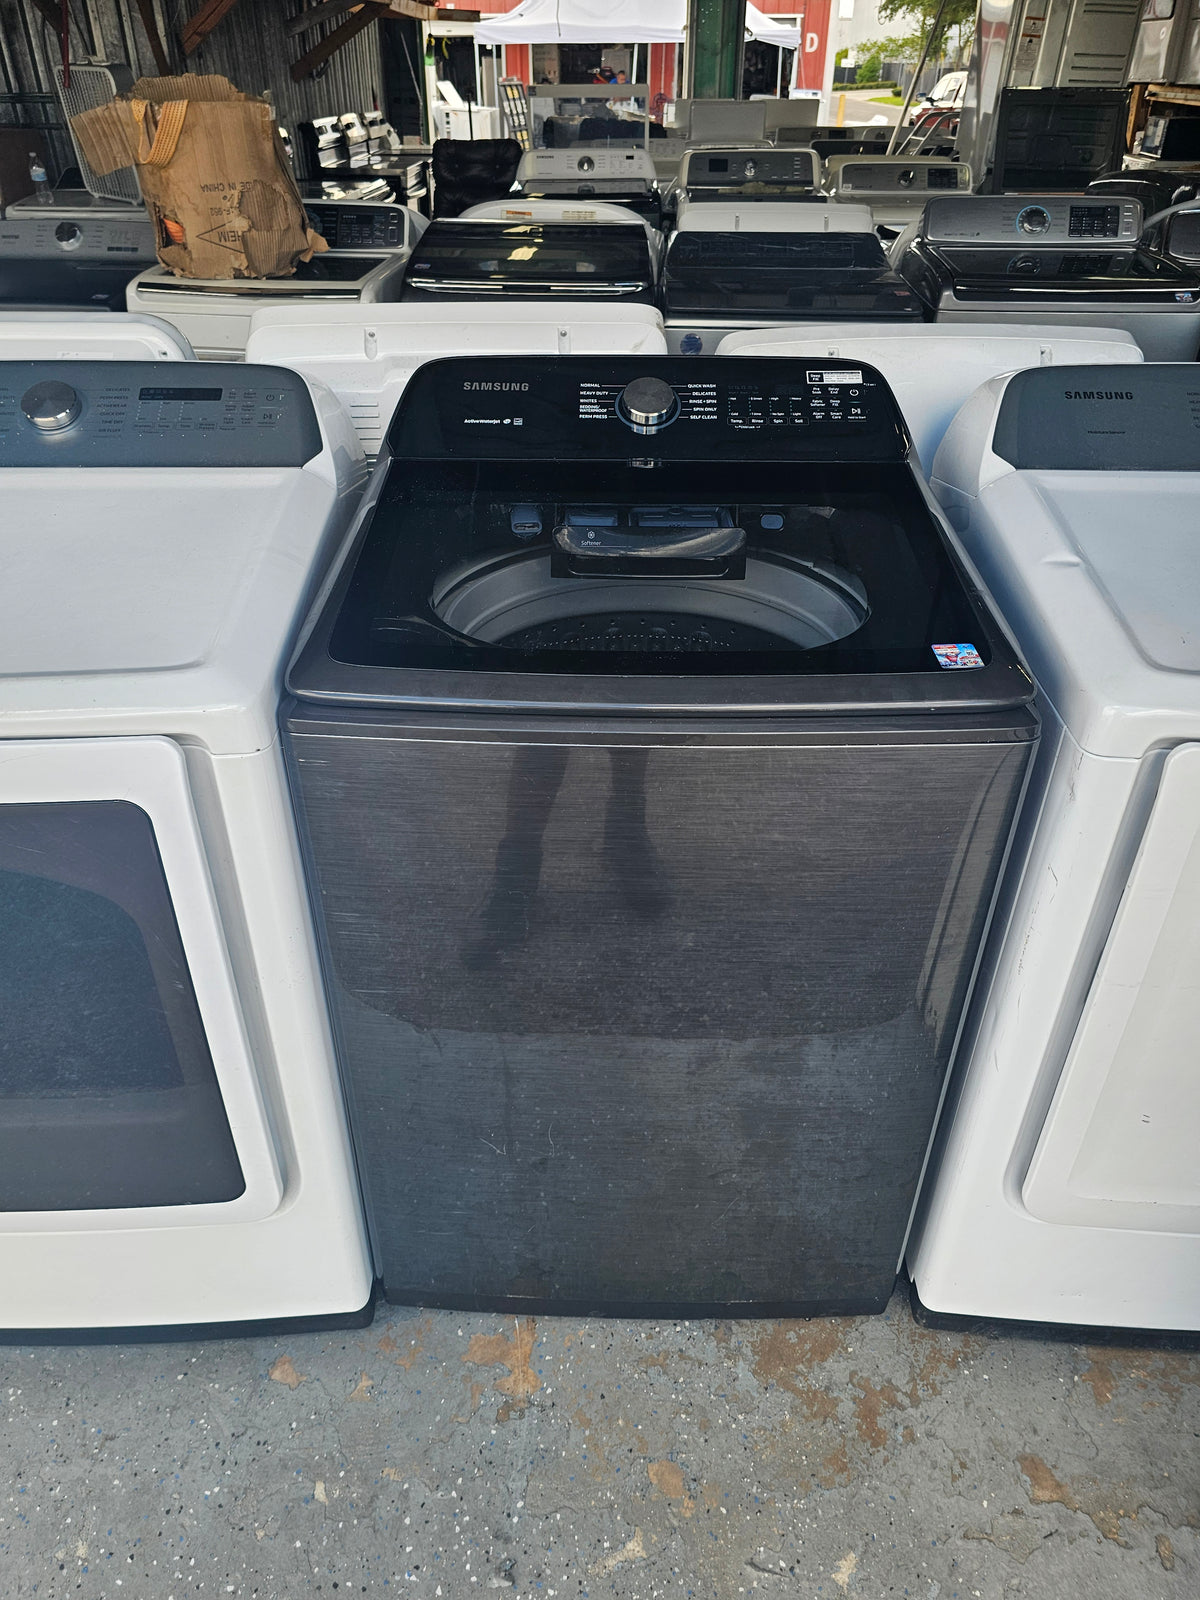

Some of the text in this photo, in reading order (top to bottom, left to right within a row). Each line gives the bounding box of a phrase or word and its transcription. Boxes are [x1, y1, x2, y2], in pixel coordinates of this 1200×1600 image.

[805, 32, 819, 52] D
[200, 183, 225, 193] CHINA
[463, 382, 529, 391] SAMSUNG
[1064, 391, 1134, 400] SAMSUNG
